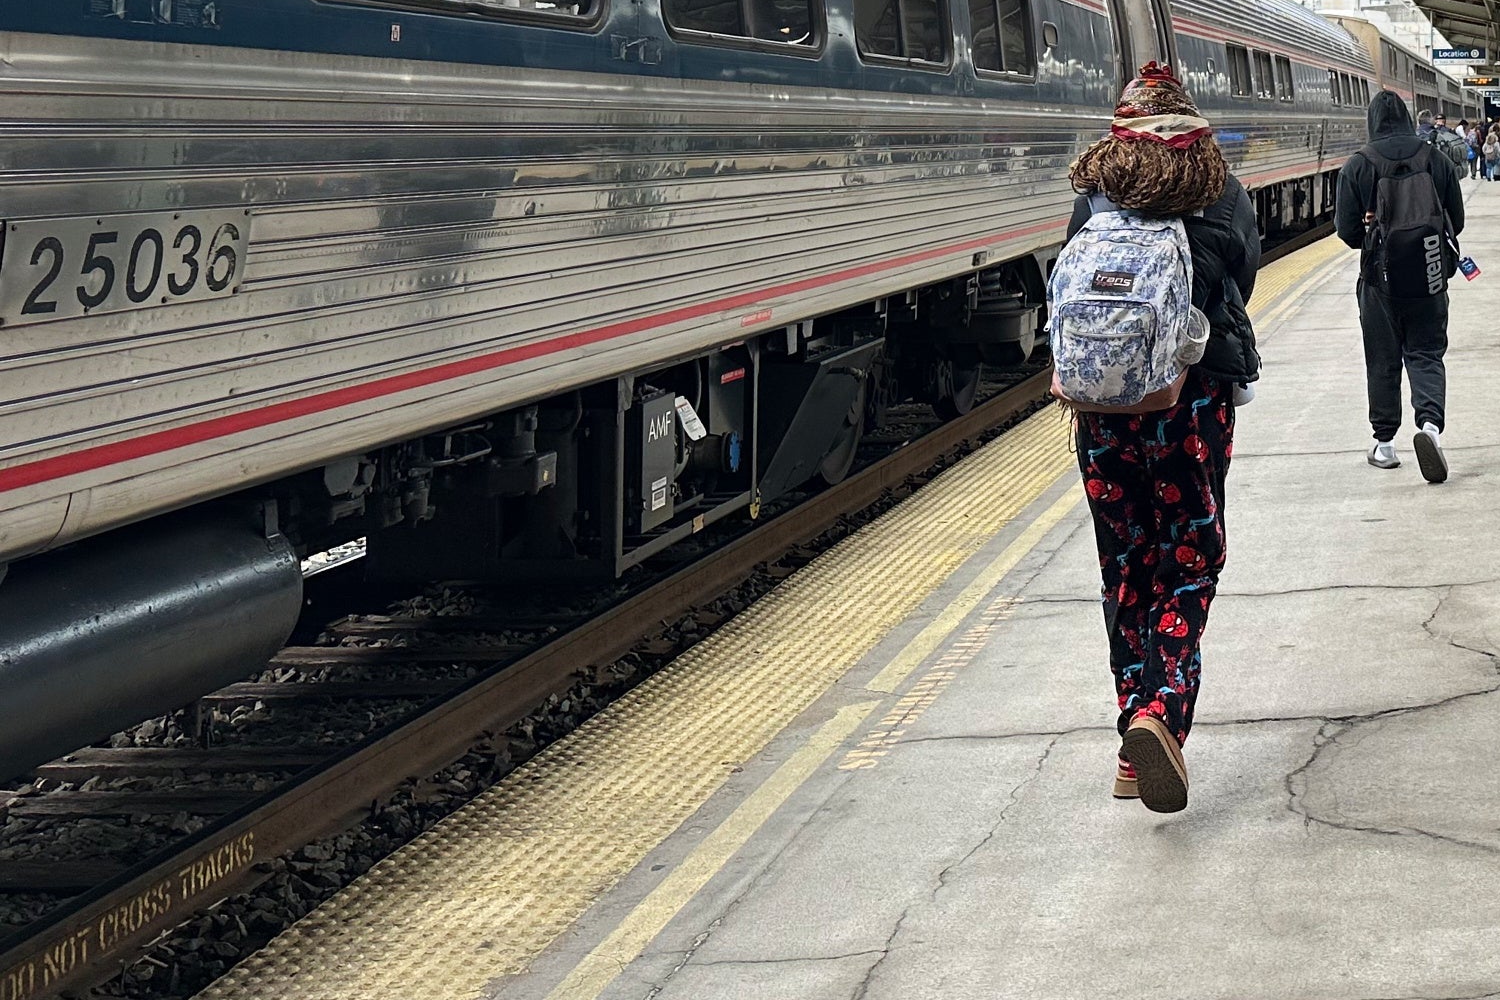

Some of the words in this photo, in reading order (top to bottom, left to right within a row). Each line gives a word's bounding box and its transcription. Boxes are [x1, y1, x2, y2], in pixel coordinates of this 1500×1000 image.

[1438, 50, 1470, 58] Location
[21, 222, 241, 315] 25036
[1096, 274, 1132, 287] trans
[1423, 234, 1443, 295] arena
[648, 411, 672, 443] AMF
[44, 927, 92, 988] NOT
[99, 880, 172, 951] CROSS
[179, 831, 254, 901] TRACKS
